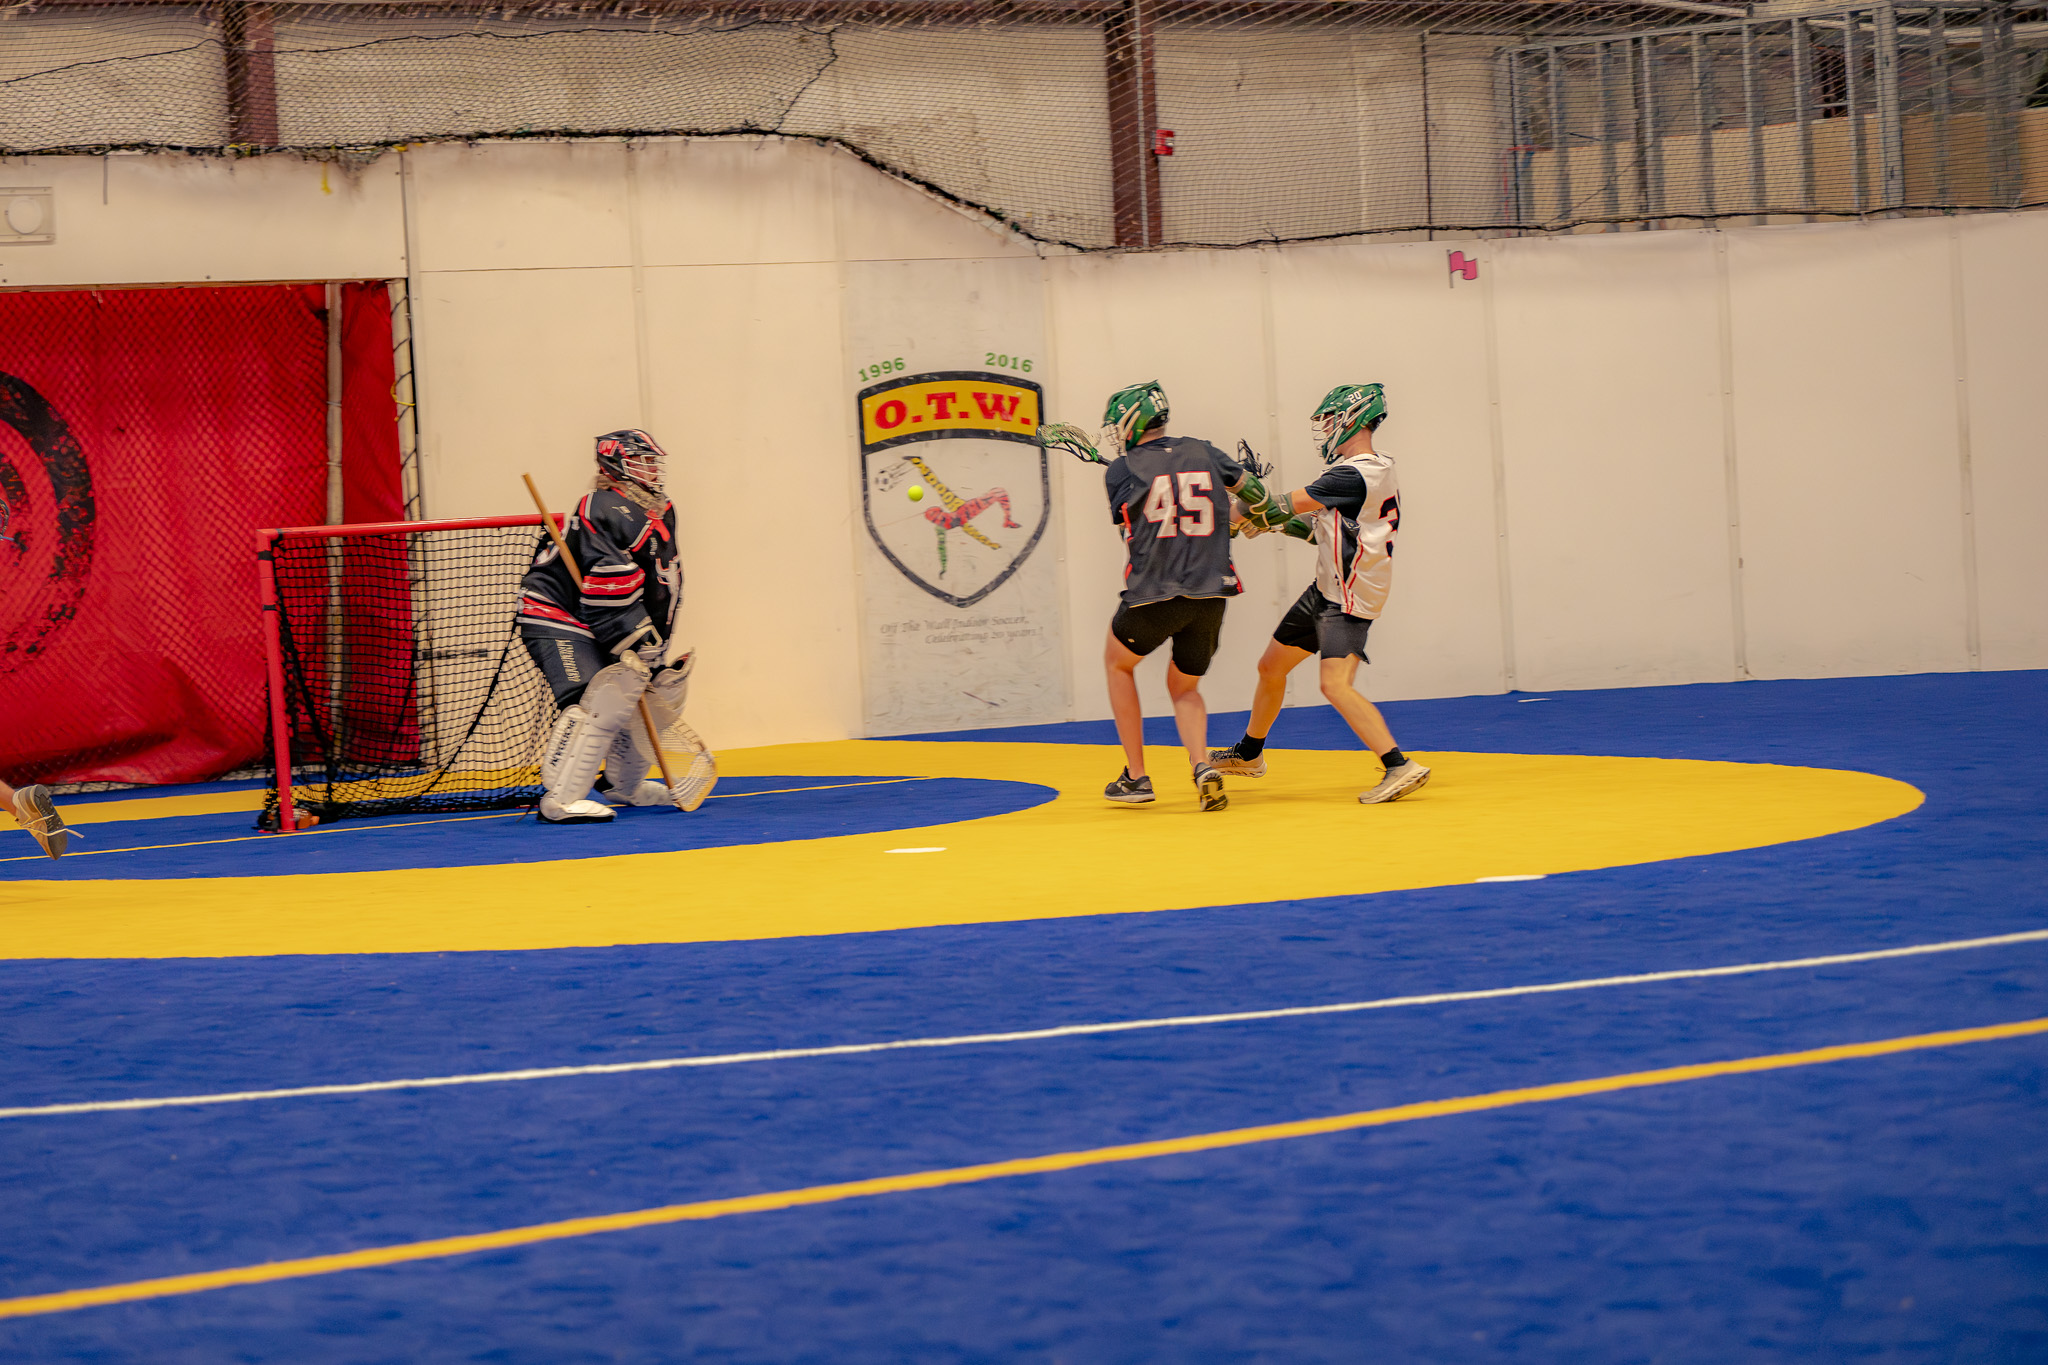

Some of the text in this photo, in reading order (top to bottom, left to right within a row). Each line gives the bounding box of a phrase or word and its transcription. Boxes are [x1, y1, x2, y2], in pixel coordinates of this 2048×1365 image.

[858, 357, 906, 382] 1996
[985, 352, 1033, 373] 2016
[1348, 390, 1362, 403] 20
[875, 391, 1032, 429] O.T.W.
[1143, 471, 1215, 538] 45
